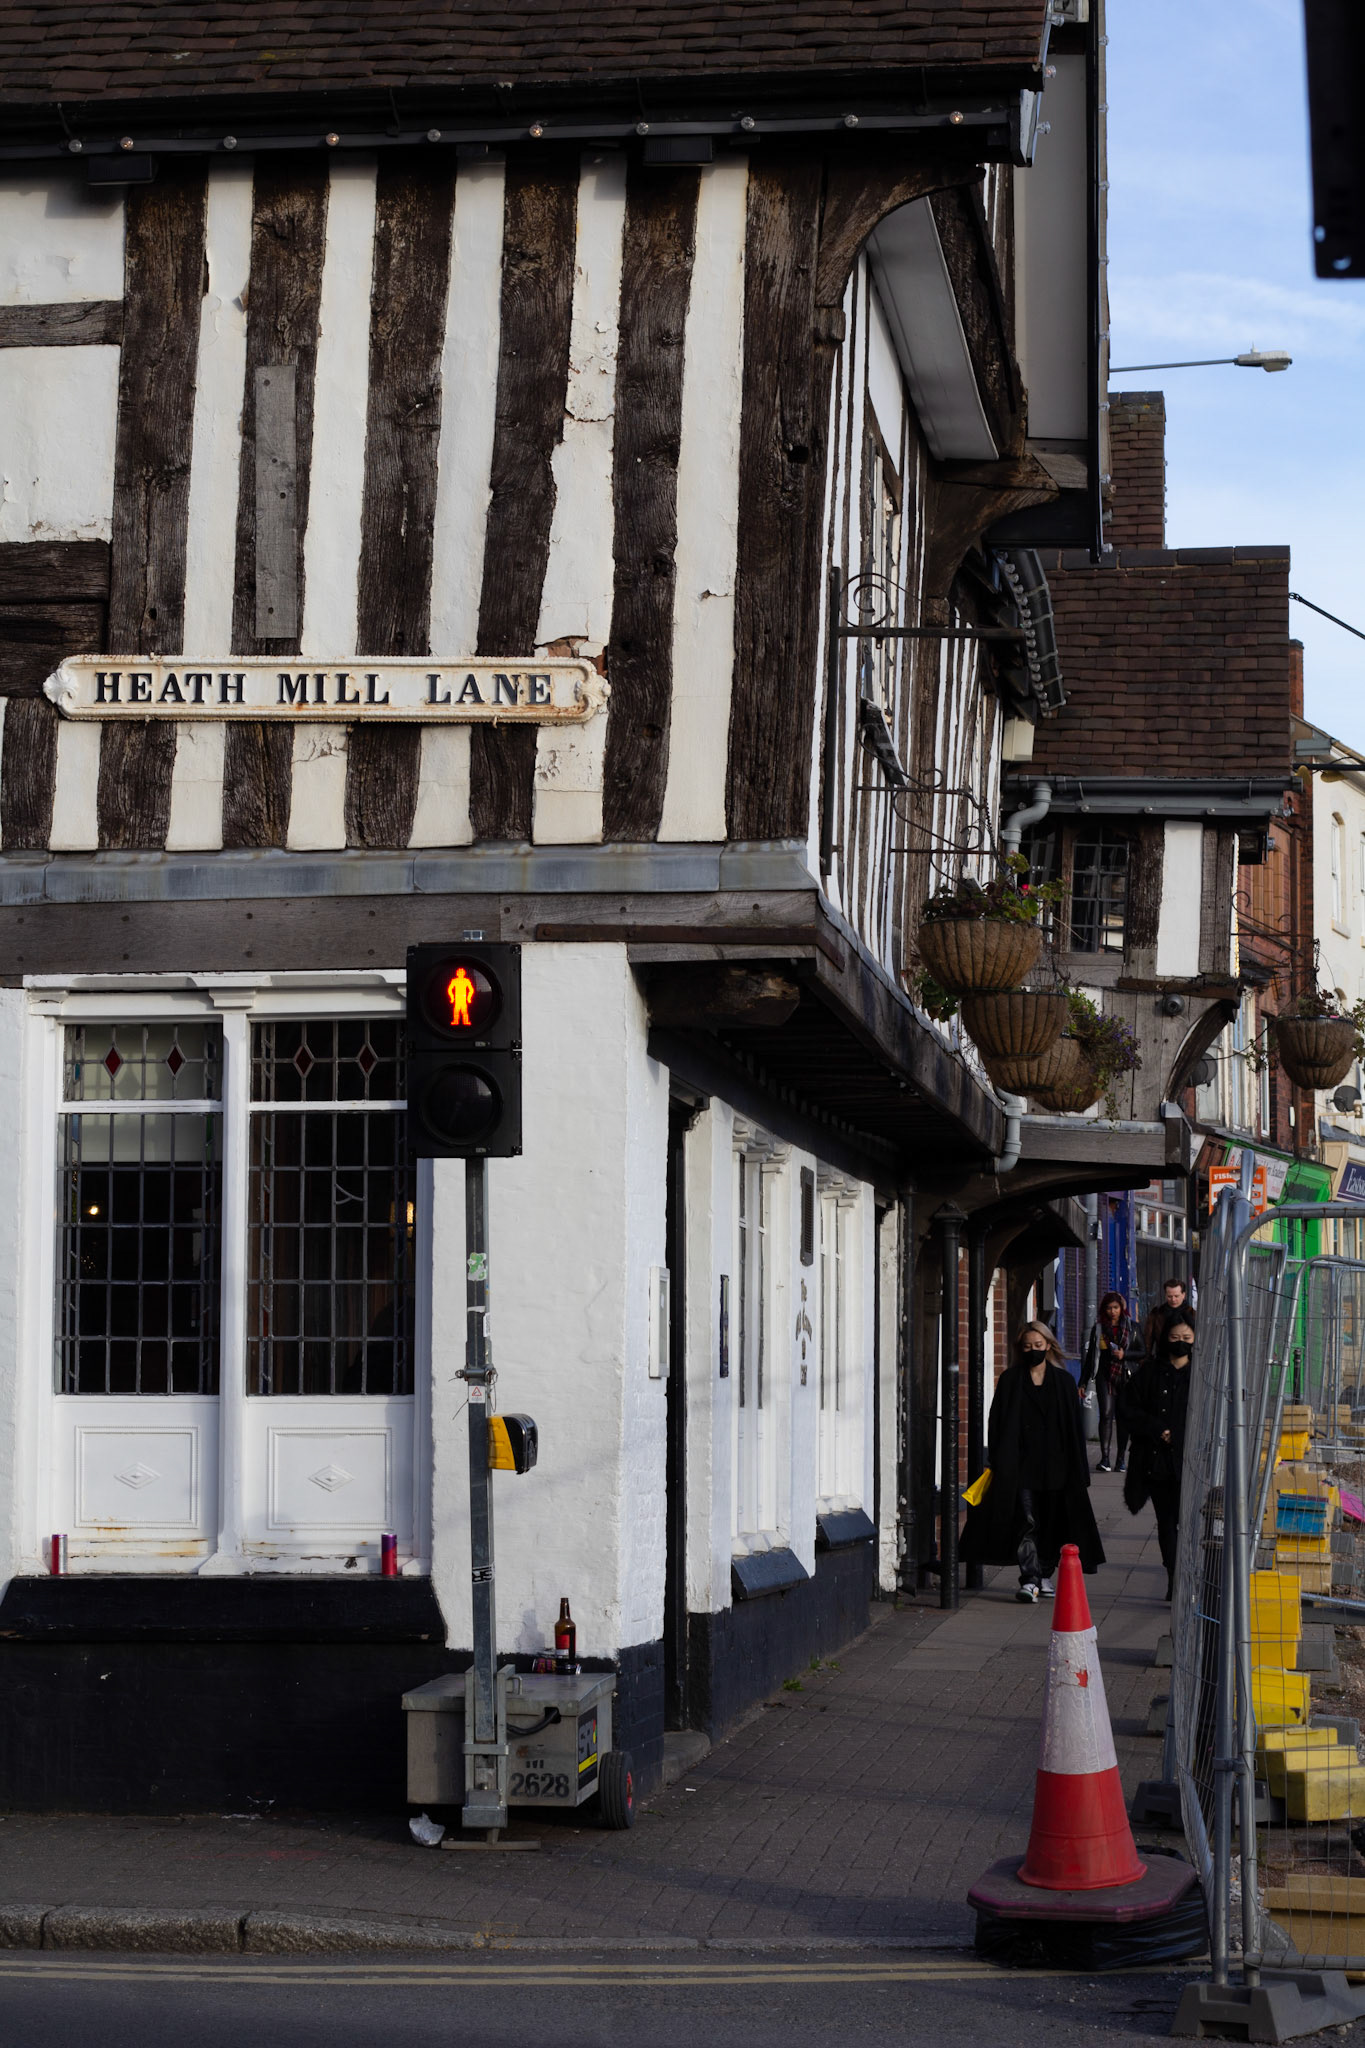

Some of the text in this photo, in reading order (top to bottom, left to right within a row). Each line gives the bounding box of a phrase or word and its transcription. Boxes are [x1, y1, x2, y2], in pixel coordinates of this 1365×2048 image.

[95, 672, 551, 705] HEATH MILL LANE
[510, 1772, 570, 1798] 2628
